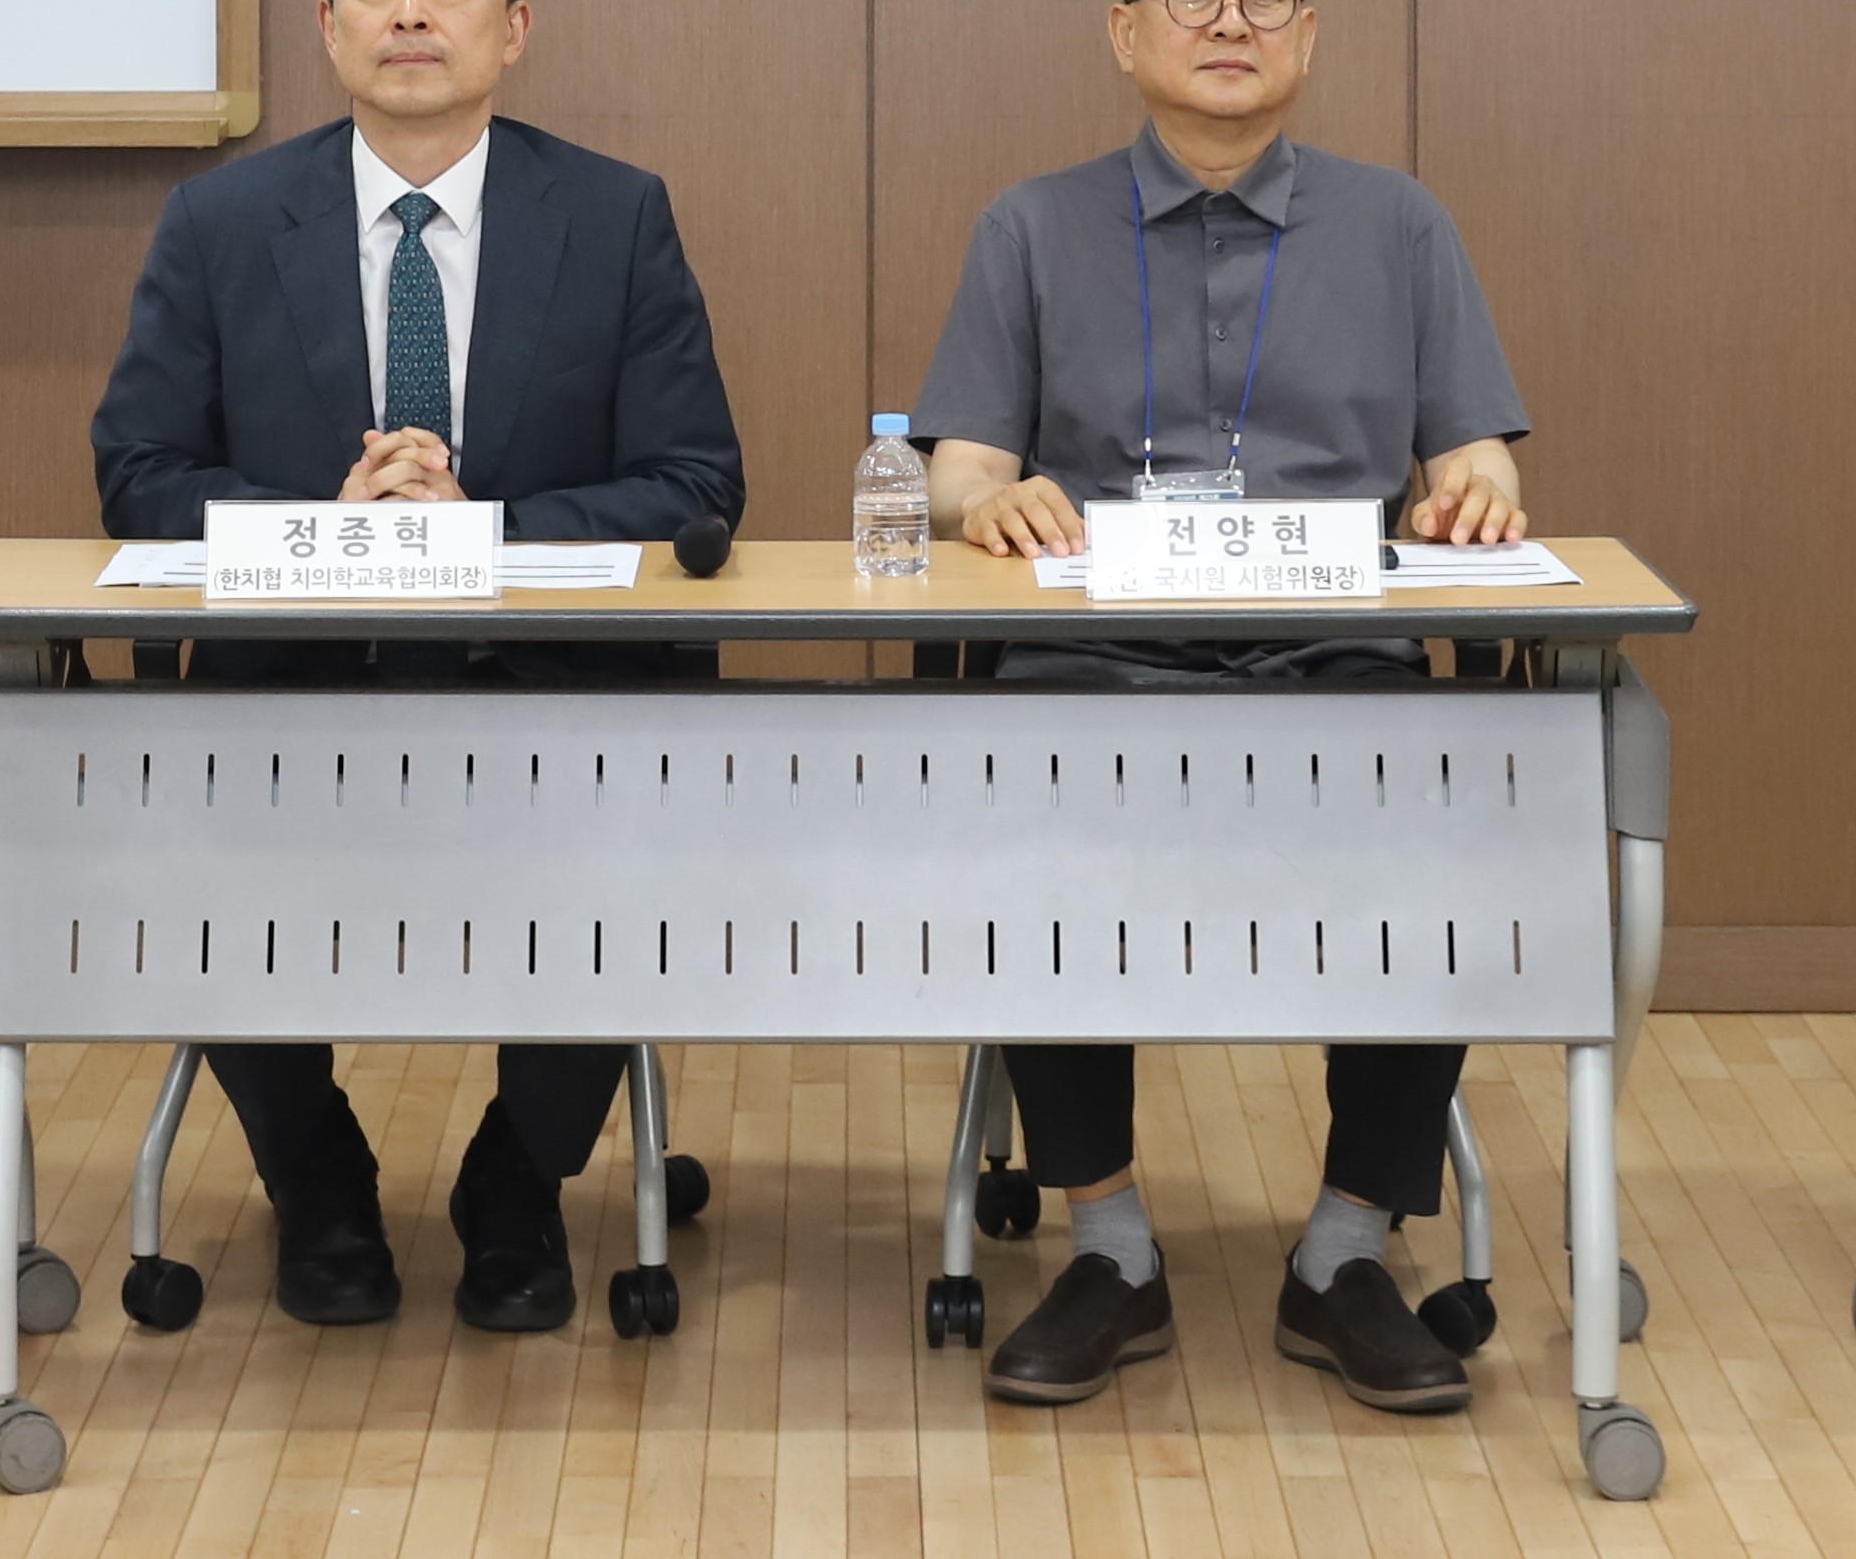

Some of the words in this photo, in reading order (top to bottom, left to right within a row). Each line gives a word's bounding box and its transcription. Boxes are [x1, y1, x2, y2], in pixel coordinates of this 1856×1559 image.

[214, 568, 282, 592] (한치협
[290, 565, 488, 591] 치의학교육협의회장)
[1154, 567, 1226, 592] 국시원
[1238, 565, 1365, 591] 시험위원장)
